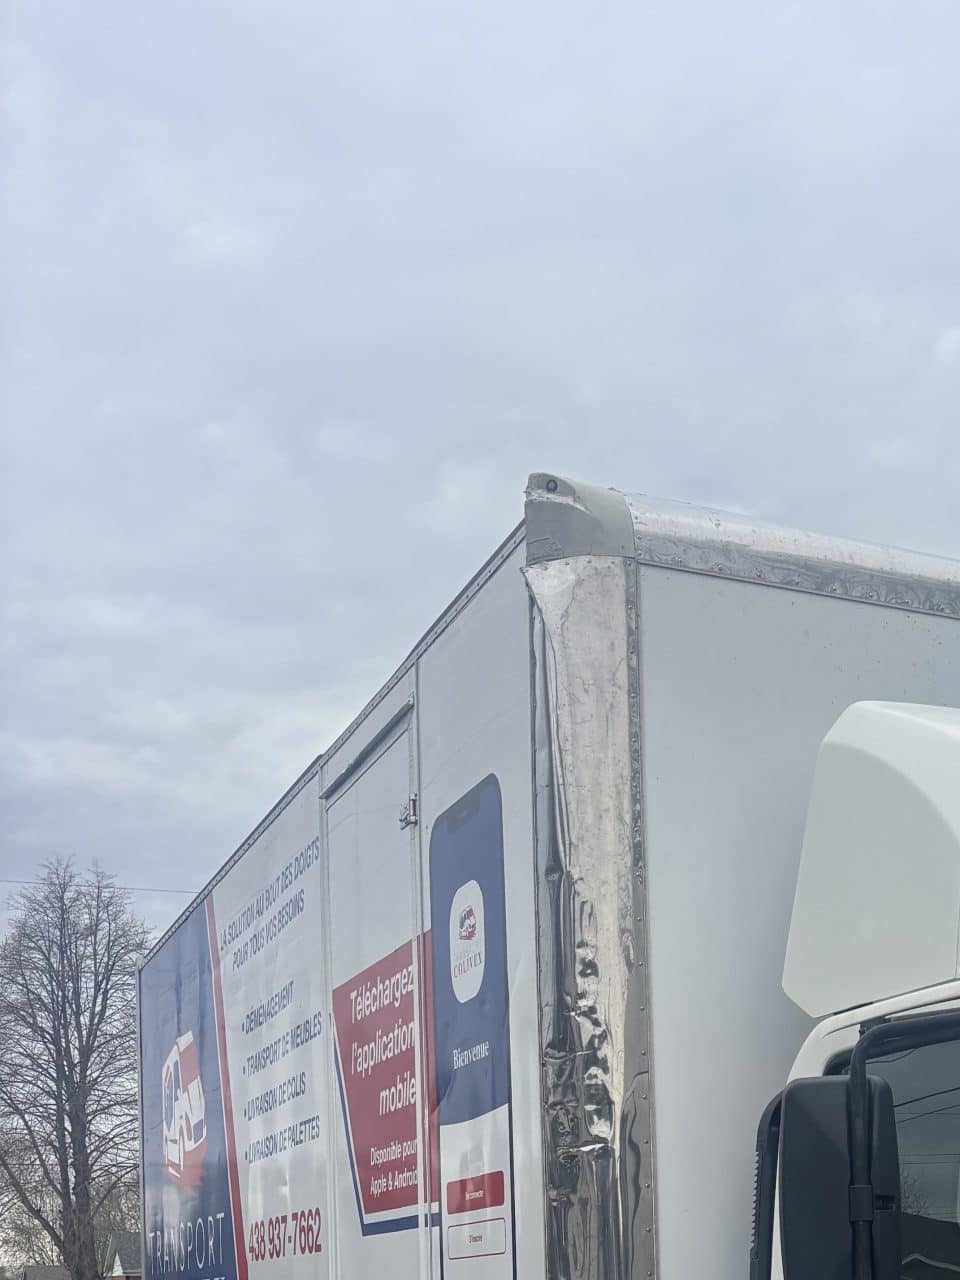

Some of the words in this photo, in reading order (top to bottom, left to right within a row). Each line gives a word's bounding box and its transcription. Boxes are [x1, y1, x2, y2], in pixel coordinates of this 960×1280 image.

[228, 903, 255, 945] SOLUTION
[255, 893, 264, 921] AU
[265, 876, 281, 910] BOUT
[281, 862, 293, 894] DES
[294, 835, 320, 881] DOIGTS
[232, 941, 248, 972] POUR
[249, 927, 265, 959] TOUS
[265, 918, 277, 945] VOS
[278, 888, 305, 933] BESOINS
[350, 964, 415, 1025] Téléchargez
[246, 1037, 281, 1078] TRANSPORT
[282, 1031, 289, 1057] DE
[290, 1010, 322, 1051] MEUBLES
[351, 1018, 415, 1078] l'application
[453, 1040, 490, 1071] Bienvenue
[247, 1086, 277, 1122] LIVRAISON
[278, 1082, 286, 1106] DE
[287, 1071, 306, 1101] COLIS
[379, 1070, 417, 1116] mobile
[248, 1131, 278, 1164] LIVRAISON
[278, 1127, 288, 1151] DE
[288, 1114, 320, 1148] PALETTES
[370, 1139, 402, 1168] Disponible
[403, 1139, 417, 1161] pour
[370, 1174, 387, 1198] Apple
[388, 1171, 393, 1191] &
[149, 1212, 225, 1276] TRANSPORT
[249, 1219, 265, 1262] 438
[268, 1207, 322, 1260] 937-7662
